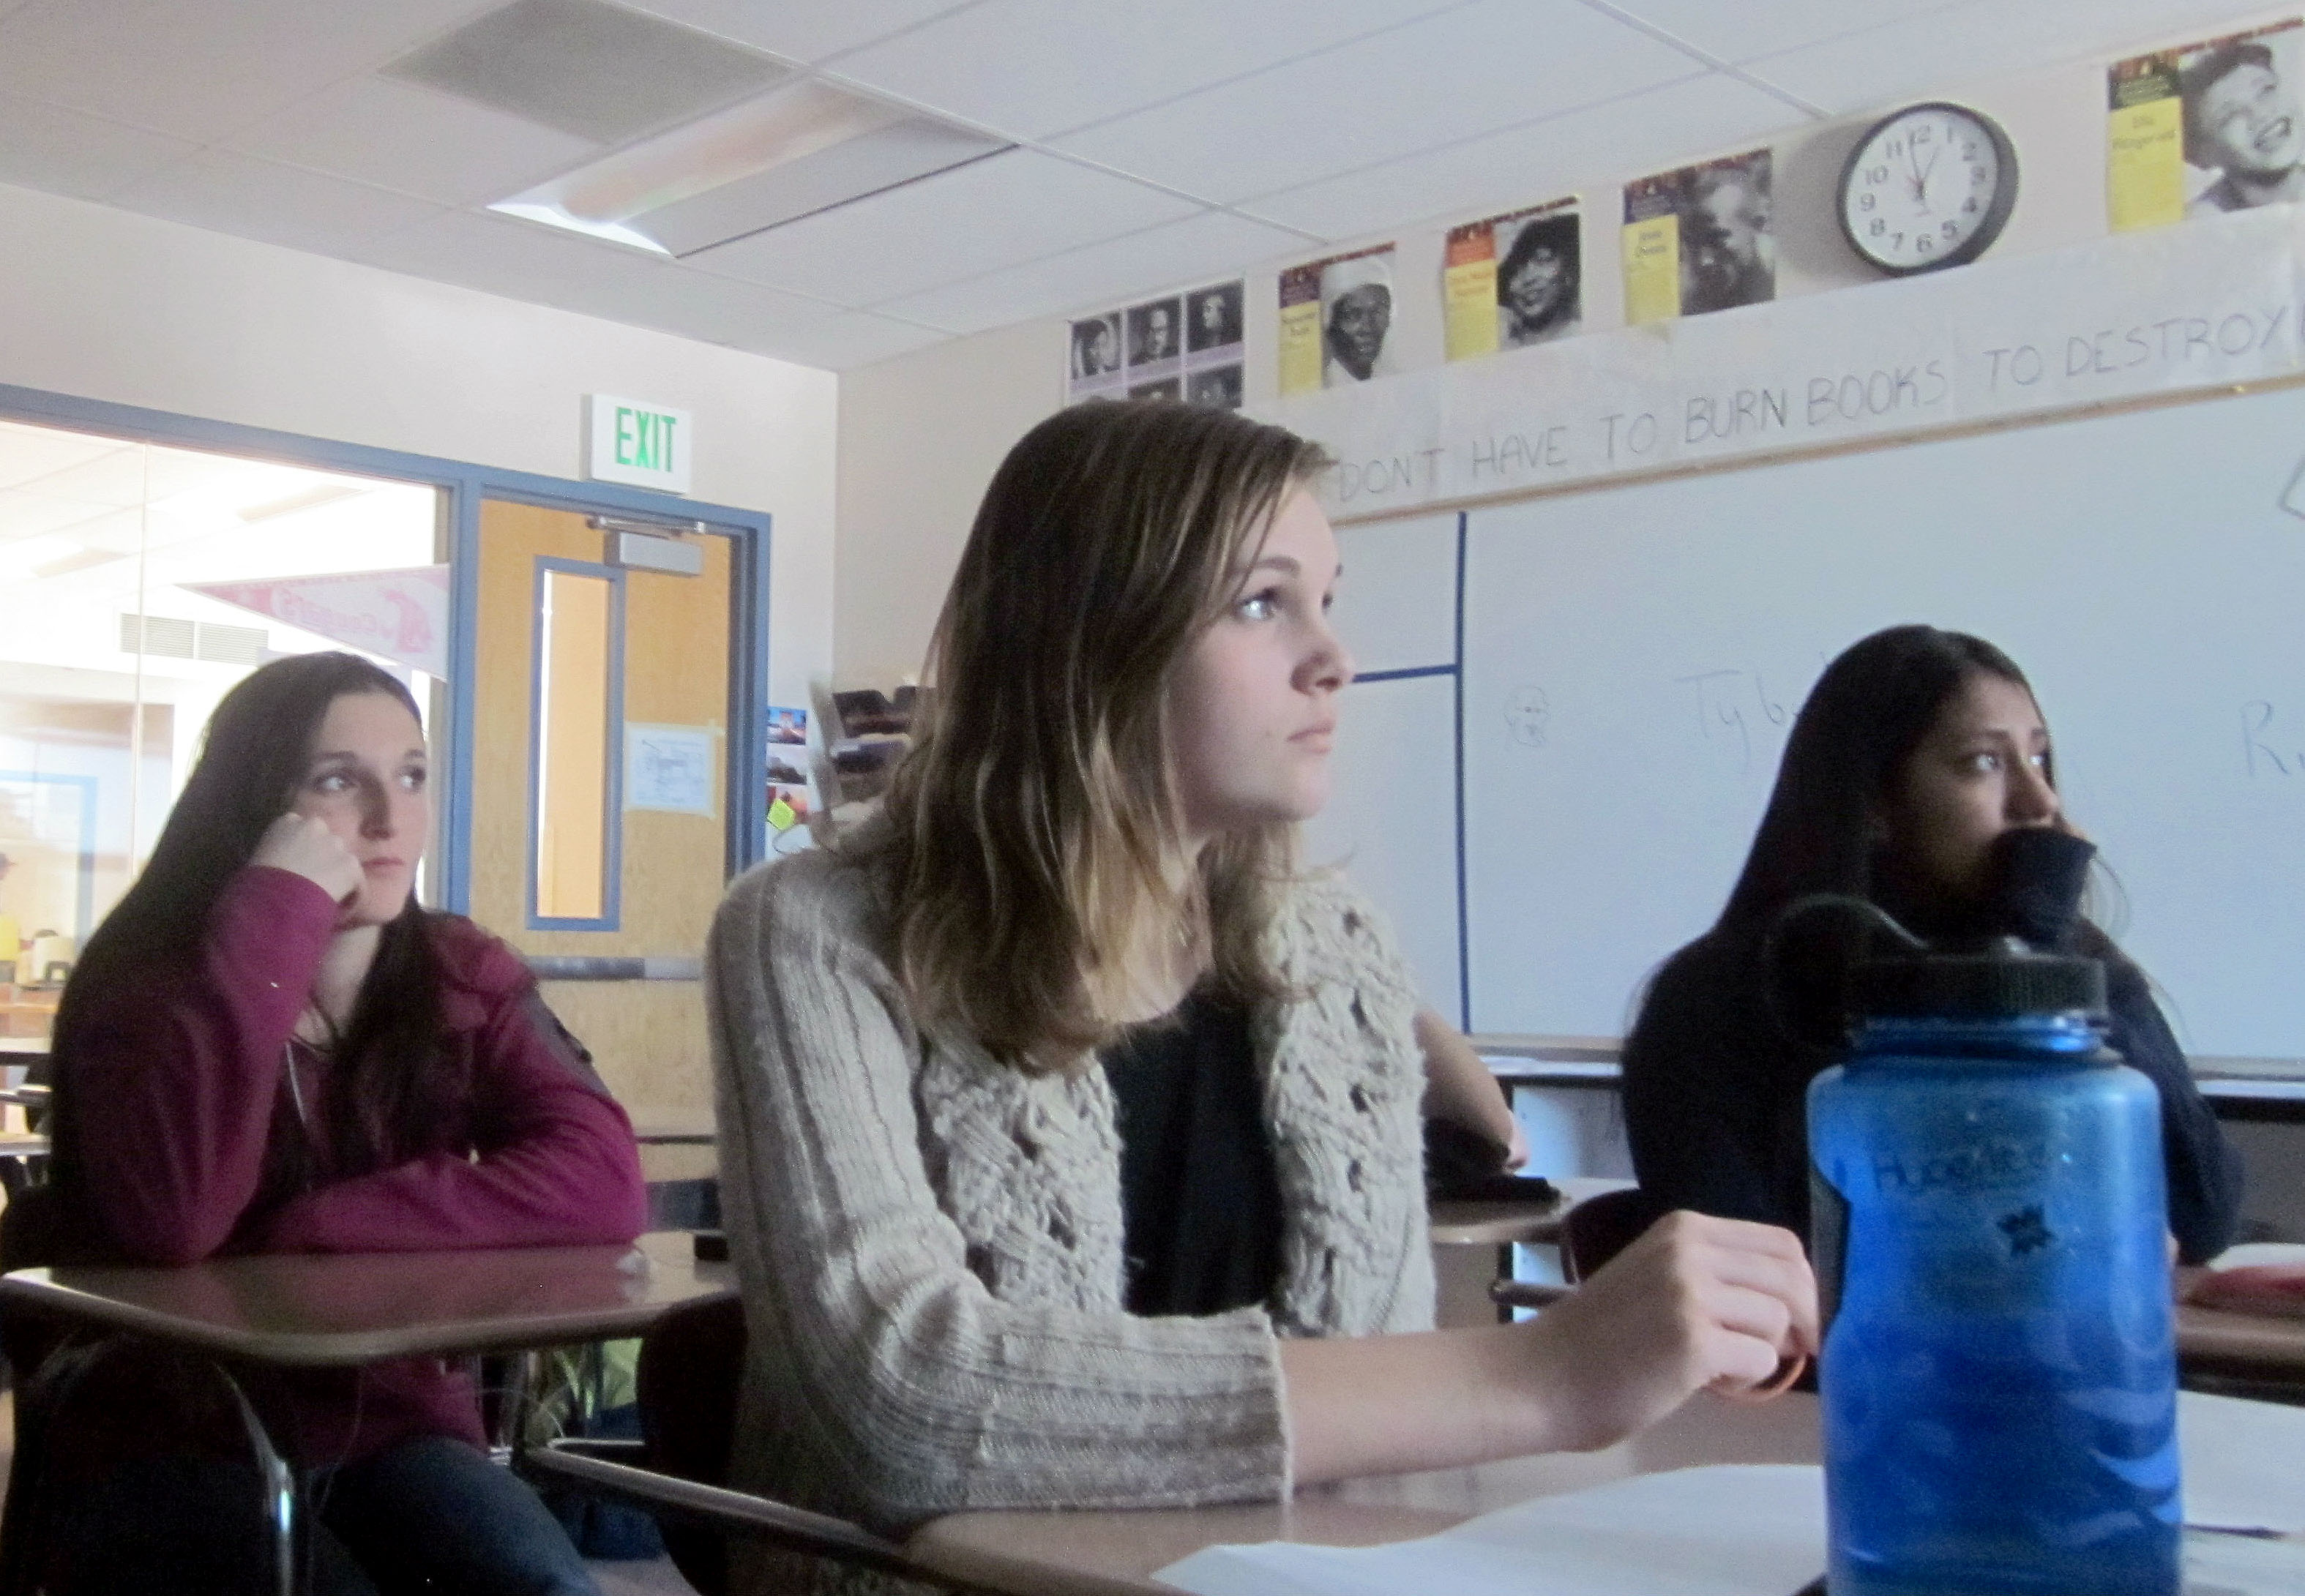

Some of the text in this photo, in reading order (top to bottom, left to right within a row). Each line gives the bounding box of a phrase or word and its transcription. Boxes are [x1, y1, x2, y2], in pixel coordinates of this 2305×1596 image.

[1886, 141, 1903, 160] 11
[1962, 141, 1978, 162] 2
[1865, 165, 1889, 186] 10
[1860, 192, 1876, 211] 9
[1869, 217, 1887, 237] 8
[1941, 219, 1959, 240] 5
[1889, 231, 1905, 252] 7
[1916, 233, 1933, 253] 6
[1472, 426, 1568, 479] HAVE
[1599, 412, 1656, 460] TO
[1685, 387, 1788, 444] BURN
[1807, 359, 1946, 426] BOOKS
[1984, 344, 2043, 391] TO
[2065, 304, 2289, 378] DESTROY
[615, 406, 677, 473] EXIT
[2238, 699, 2305, 779] R
